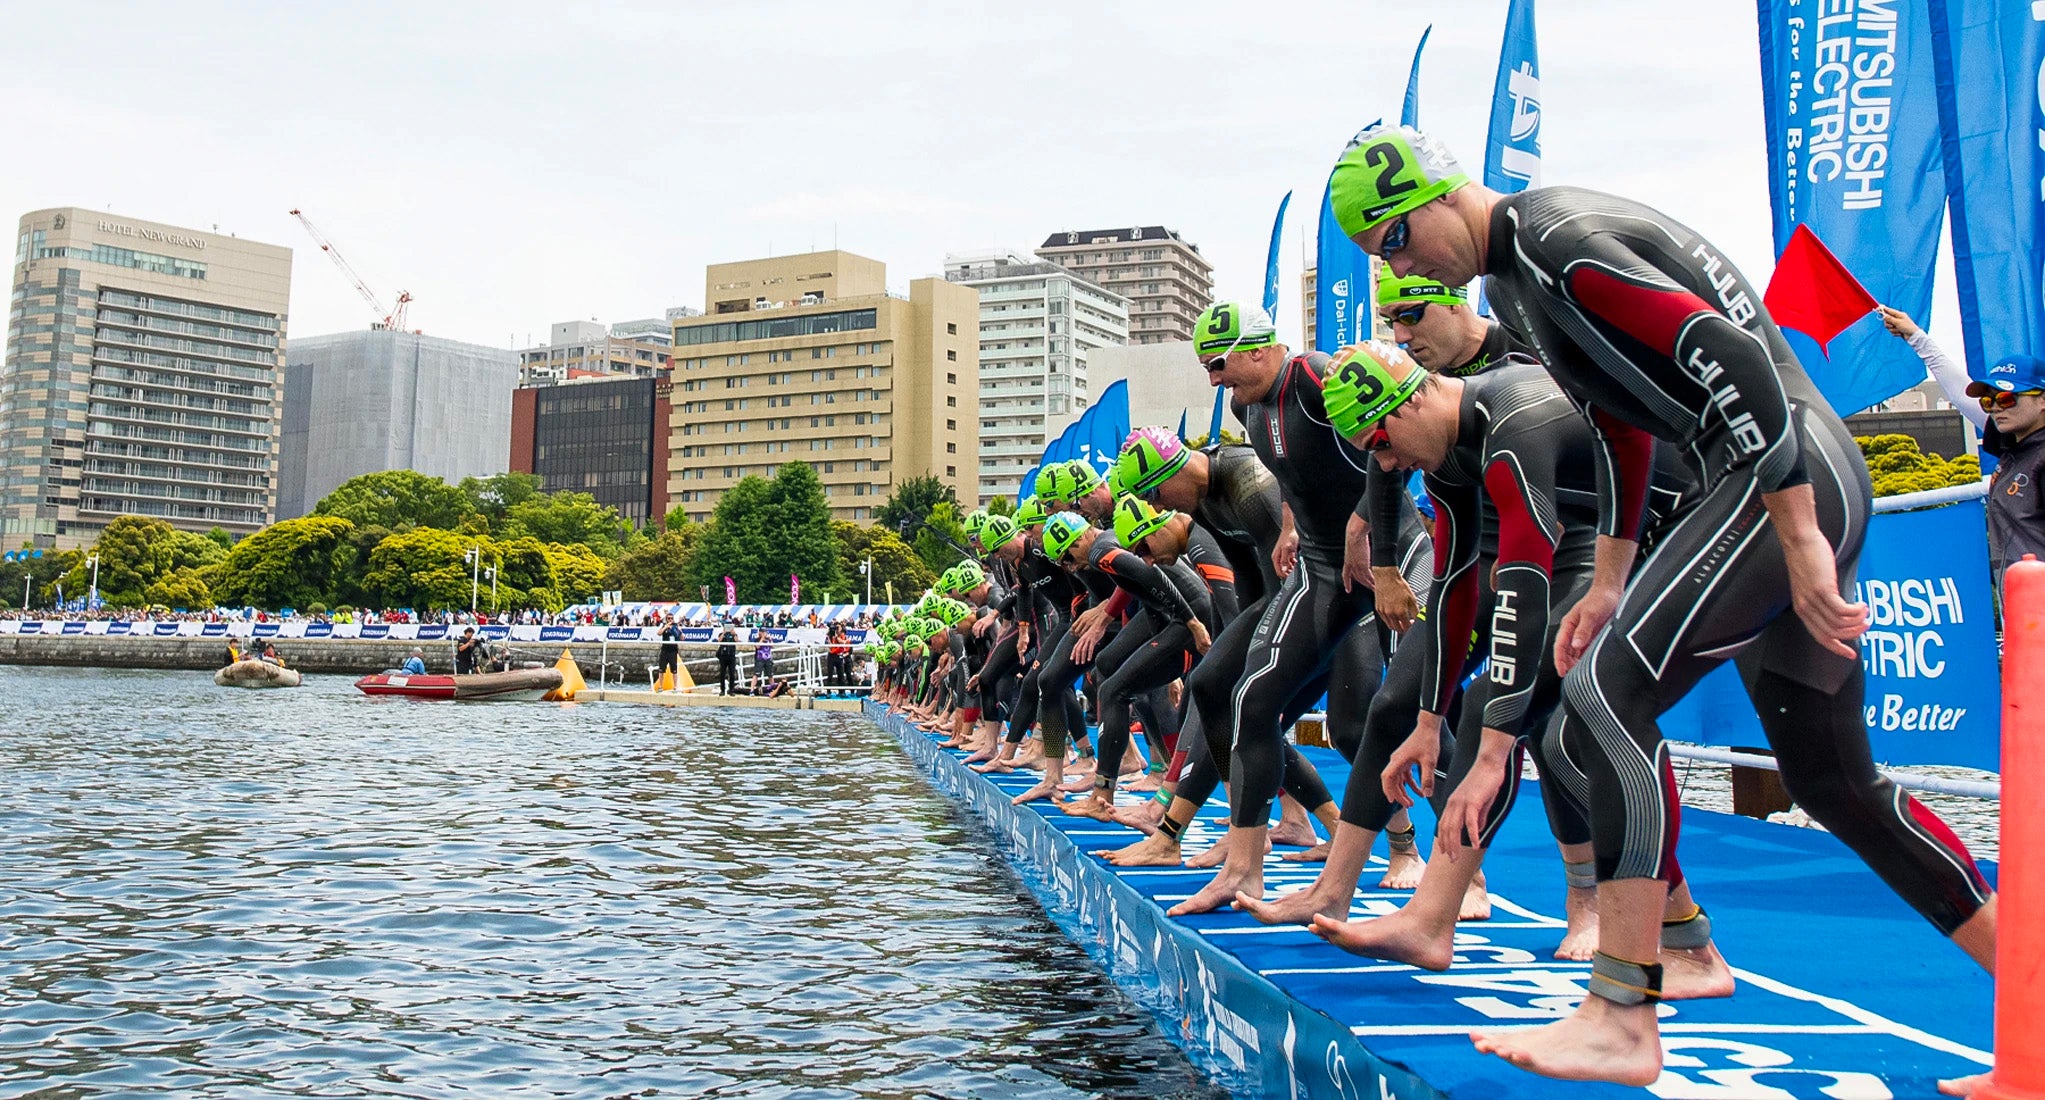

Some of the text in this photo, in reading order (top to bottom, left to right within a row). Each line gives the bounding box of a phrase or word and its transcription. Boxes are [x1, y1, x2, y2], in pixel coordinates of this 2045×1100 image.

[1788, 17, 1805, 60] for
[1788, 71, 1803, 116] the
[1807, 0, 1853, 184] ELECTRIC
[1843, 0, 1898, 210] MITSUBISHI
[1365, 141, 1419, 200] 2
[1786, 128, 1803, 222] Better
[97, 220, 207, 249] HOTEL NEW GRAND
[1692, 243, 1757, 327] HUUB
[1208, 304, 1230, 334] 5
[1340, 361, 1384, 406] 3
[1687, 347, 1767, 454] HUUB
[1069, 464, 1088, 485] 9
[1128, 443, 1149, 476] 7
[989, 518, 1012, 537] 16
[1050, 523, 1070, 544] 6
[959, 569, 975, 585] 19
[608, 631, 638, 639] YOKOHAMA
[1490, 590, 1518, 687] HUUB
[1860, 630, 1946, 679] TRIC
[1881, 694, 1967, 731] Better
